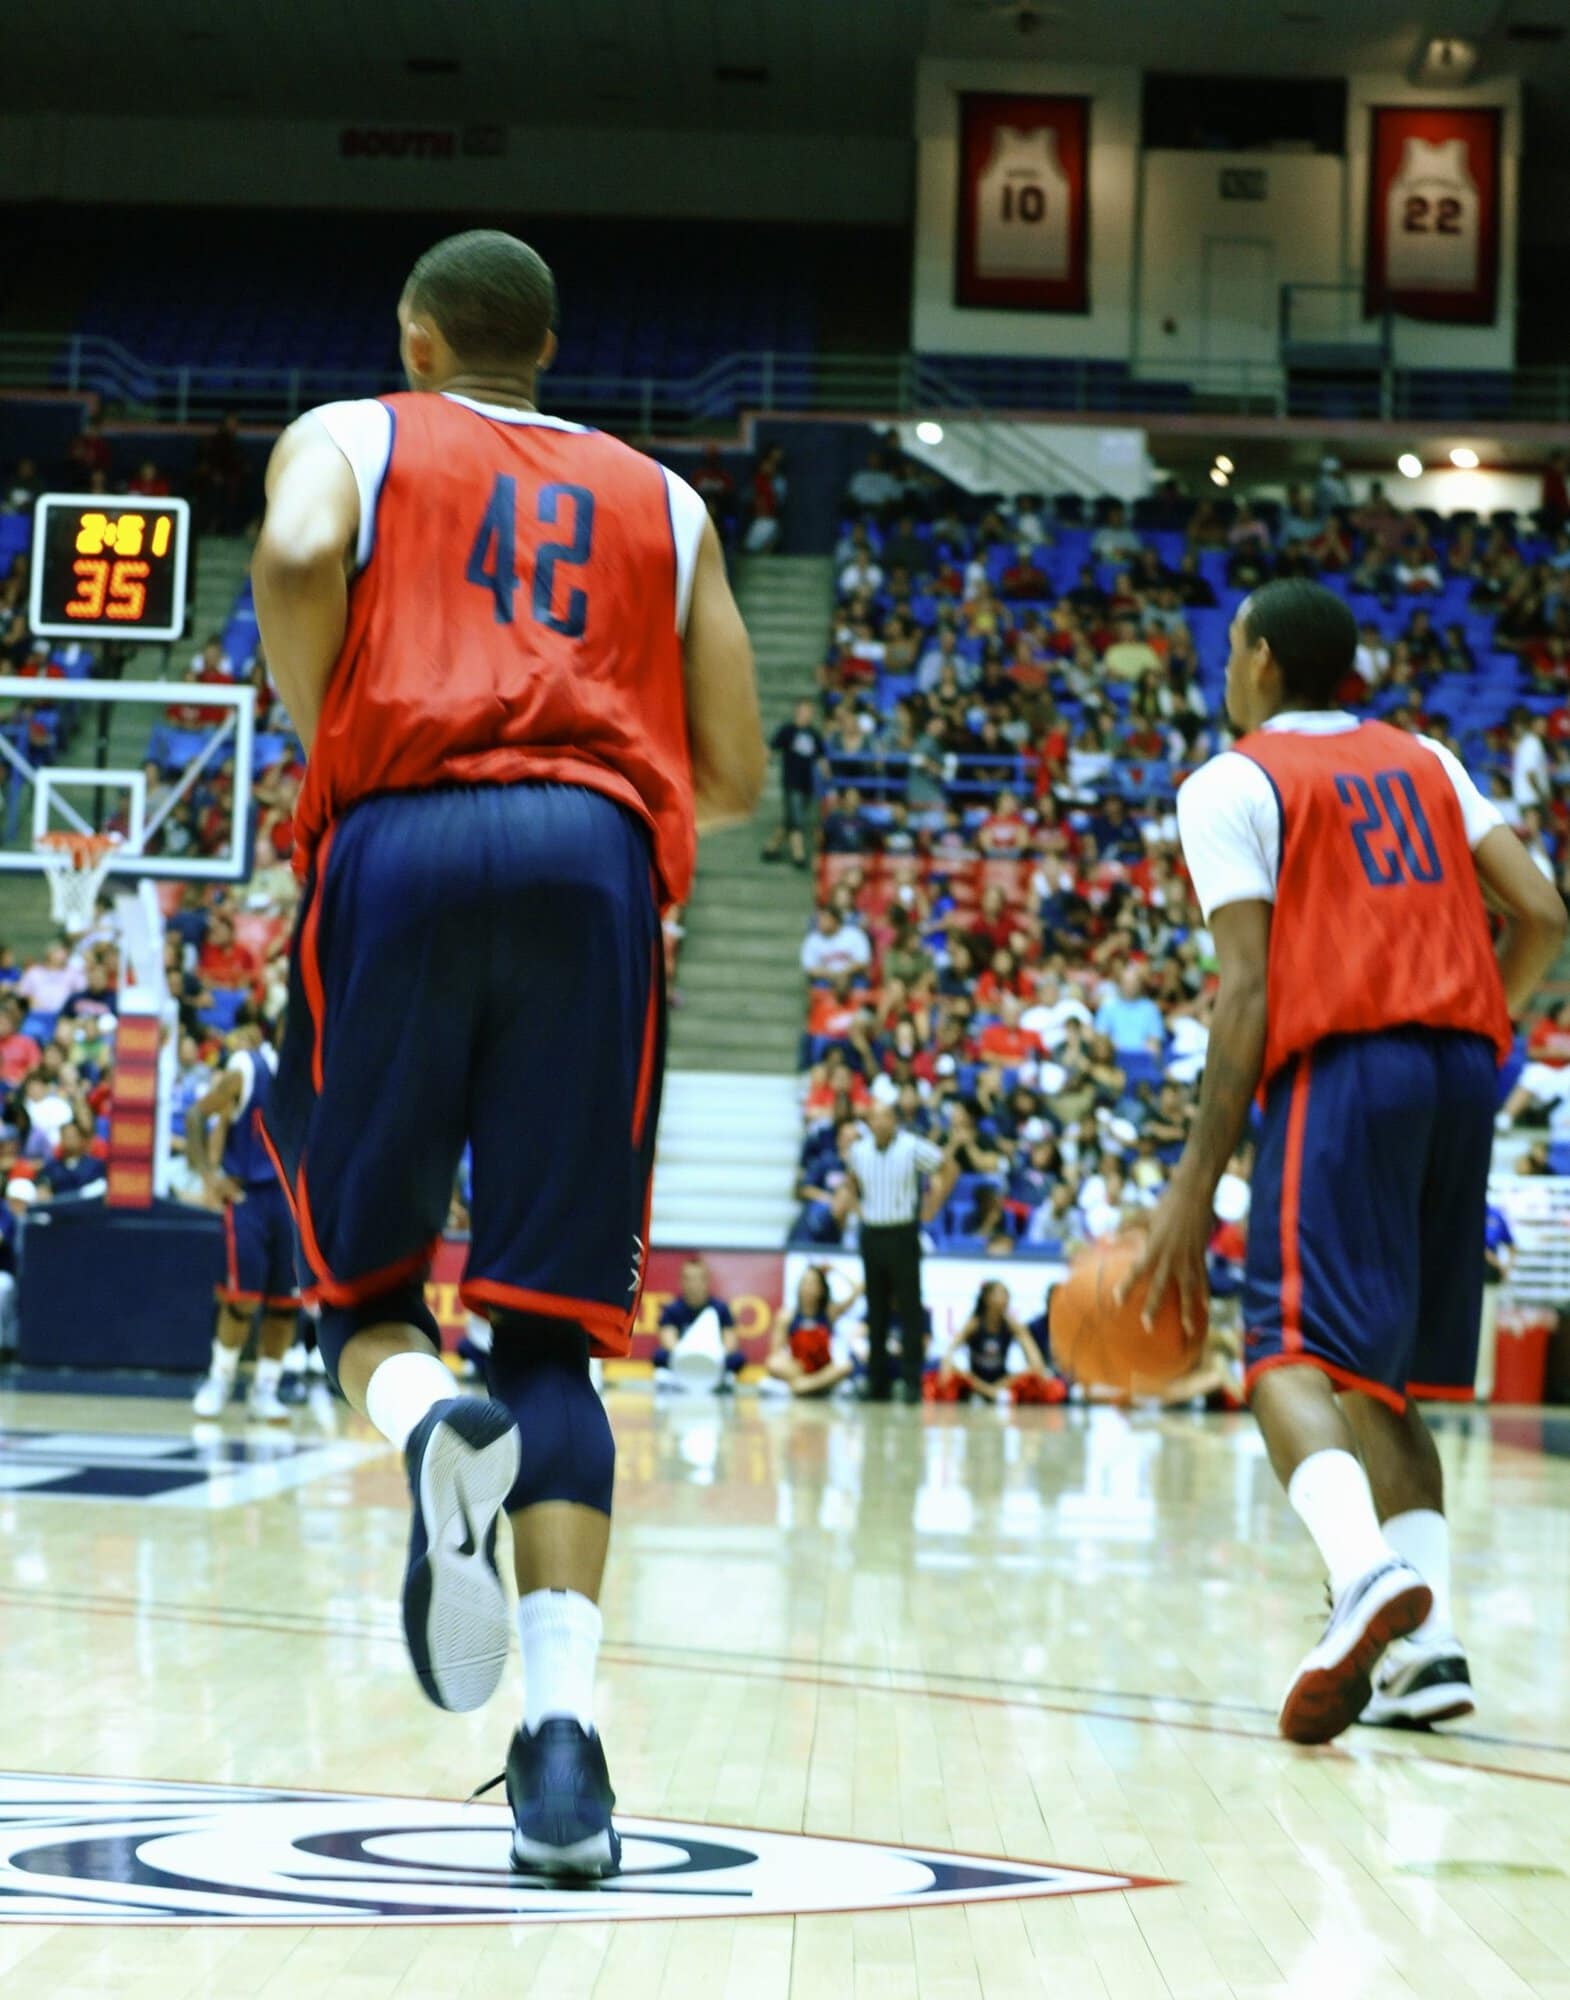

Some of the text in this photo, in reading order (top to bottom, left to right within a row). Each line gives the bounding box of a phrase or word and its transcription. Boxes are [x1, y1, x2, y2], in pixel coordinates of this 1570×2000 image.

[1001, 184, 1046, 224] 10
[1402, 195, 1462, 236] 22
[464, 471, 595, 638] 42
[65, 559, 150, 621] 35
[1333, 768, 1444, 887] 20
